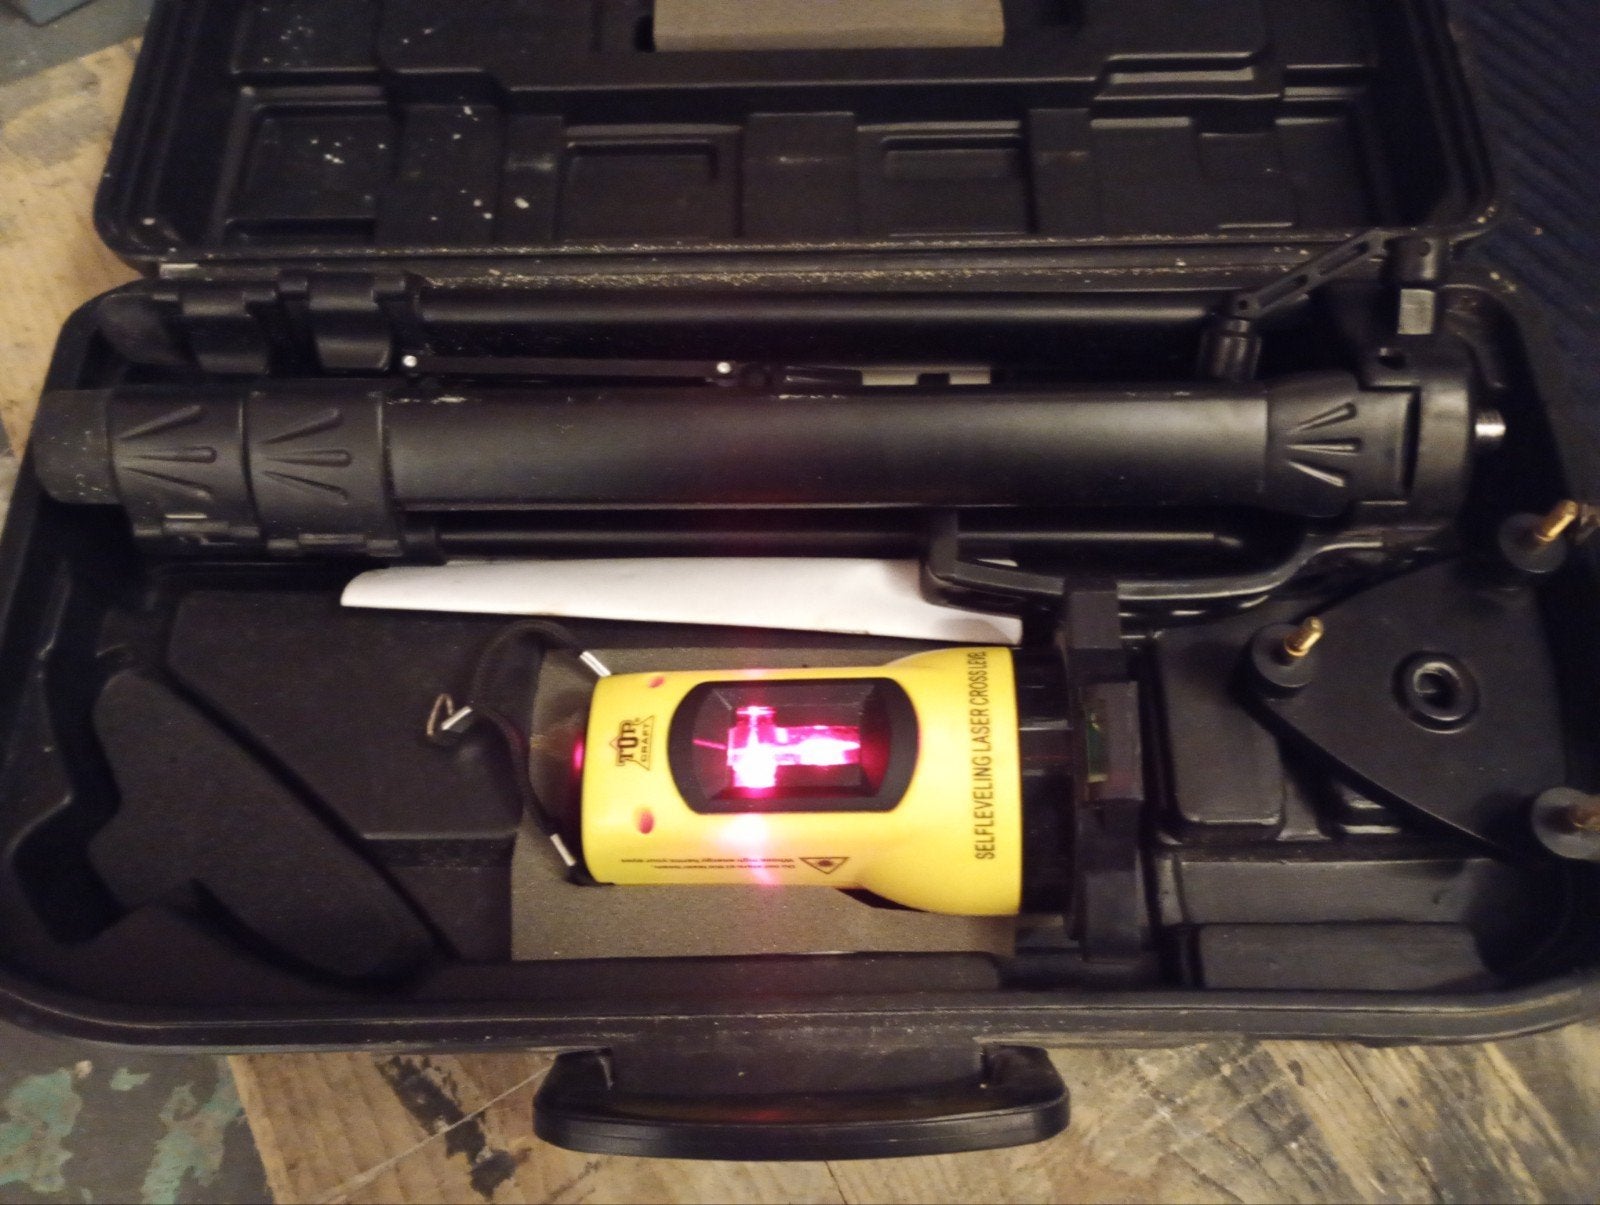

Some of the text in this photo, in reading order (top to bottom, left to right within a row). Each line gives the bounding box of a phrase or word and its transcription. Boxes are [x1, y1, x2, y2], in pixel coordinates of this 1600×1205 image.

[967, 670, 989, 706] CROSS
[616, 719, 639, 764] TOP
[641, 724, 651, 763] CRAFT
[969, 708, 992, 752] LASER
